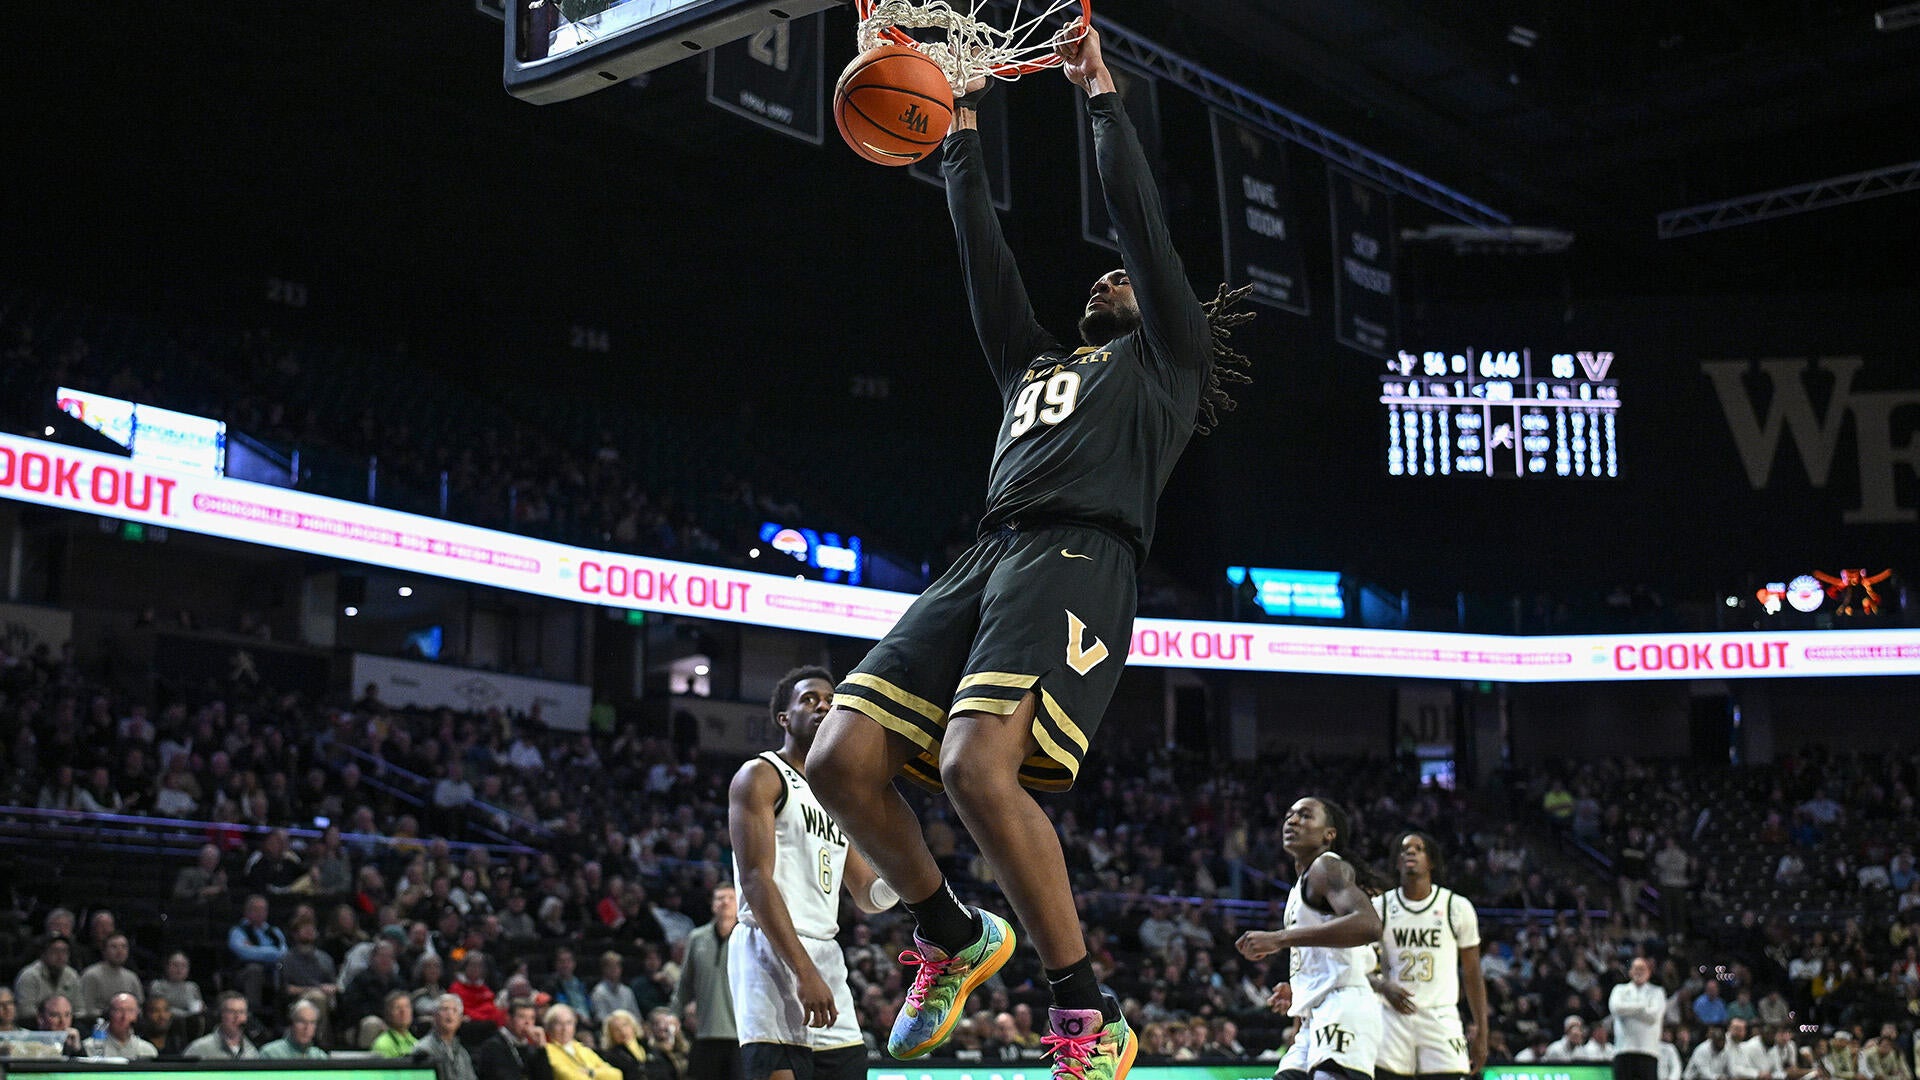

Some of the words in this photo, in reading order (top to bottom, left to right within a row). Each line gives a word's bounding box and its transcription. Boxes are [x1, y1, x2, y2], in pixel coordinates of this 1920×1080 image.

[1010, 370, 1081, 438] 99
[91, 465, 177, 516] OUT
[579, 561, 678, 604] COOK
[687, 575, 752, 613] OUT
[1192, 631, 1254, 661] OUT
[1614, 642, 1714, 671] COOK
[1721, 641, 1789, 669] OUT
[818, 846, 833, 895] 6
[1392, 927, 1441, 948] WAKE
[1398, 950, 1434, 983] 23
[1315, 1022, 1355, 1054] WF
